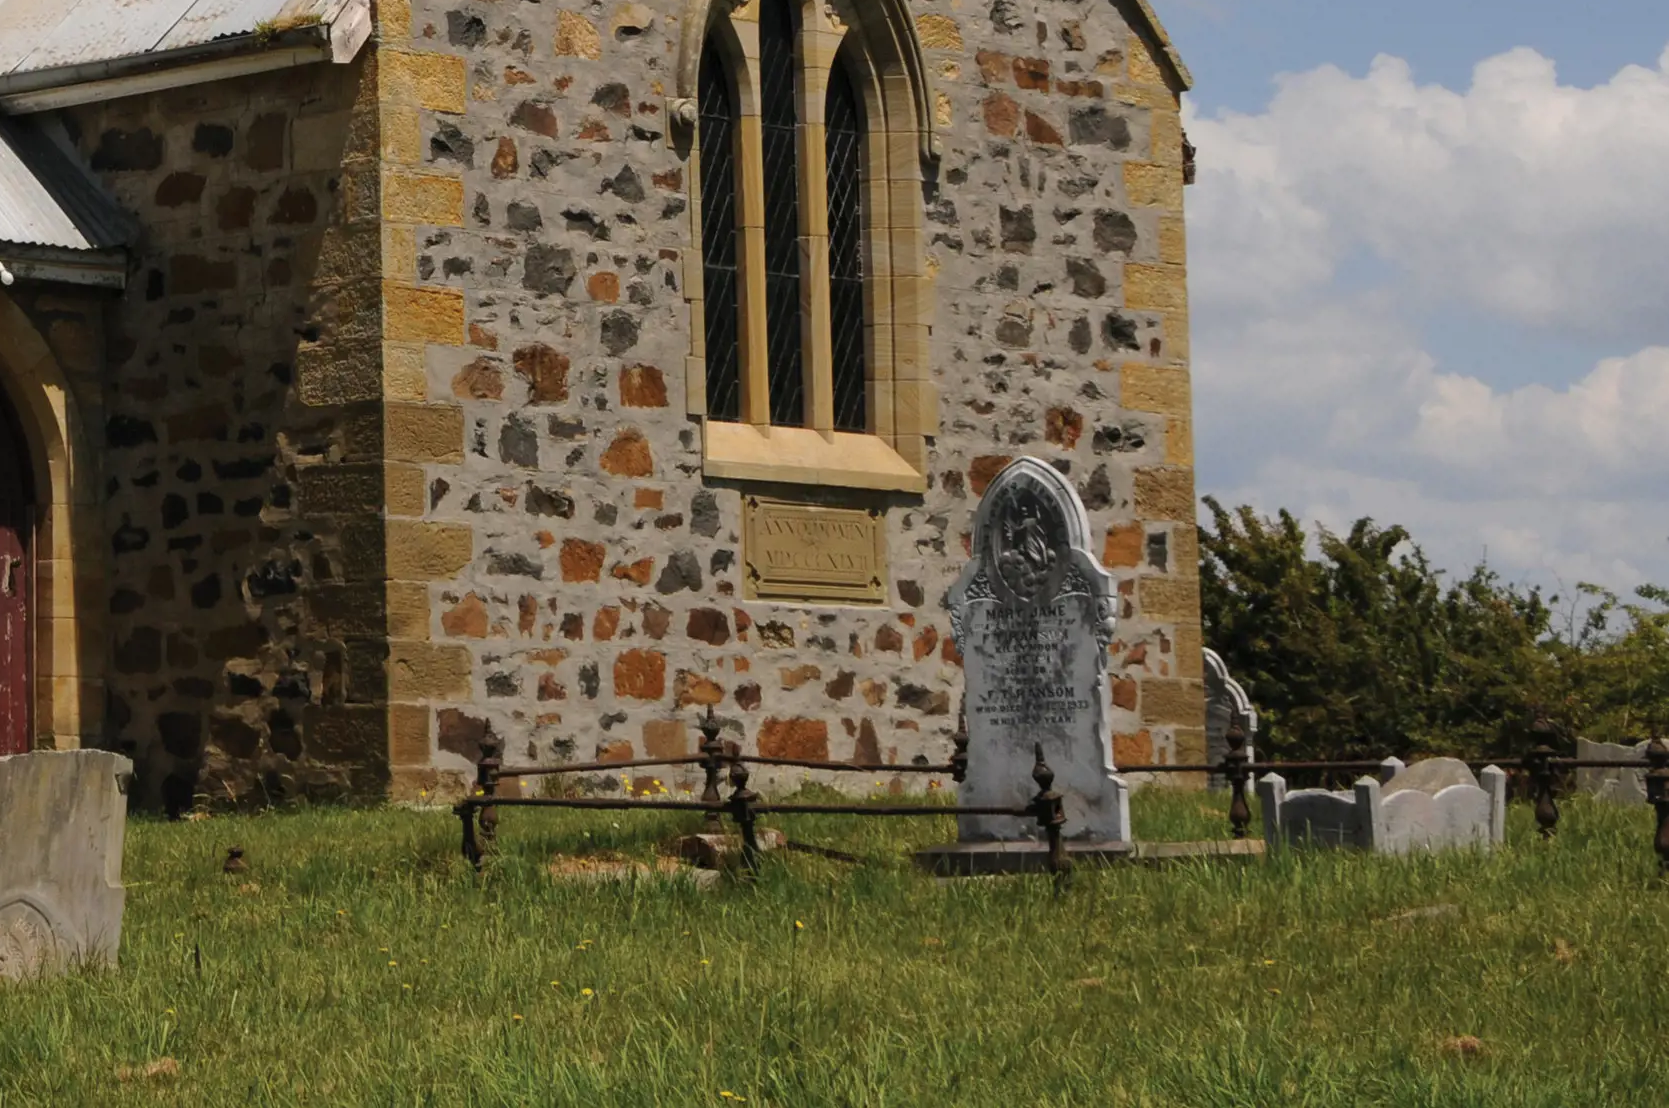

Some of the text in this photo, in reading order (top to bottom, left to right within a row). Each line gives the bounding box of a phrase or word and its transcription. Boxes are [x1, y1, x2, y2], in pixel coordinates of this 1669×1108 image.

[986, 605, 1066, 620] MARY JANE
[1016, 687, 1074, 699] RANSOM
